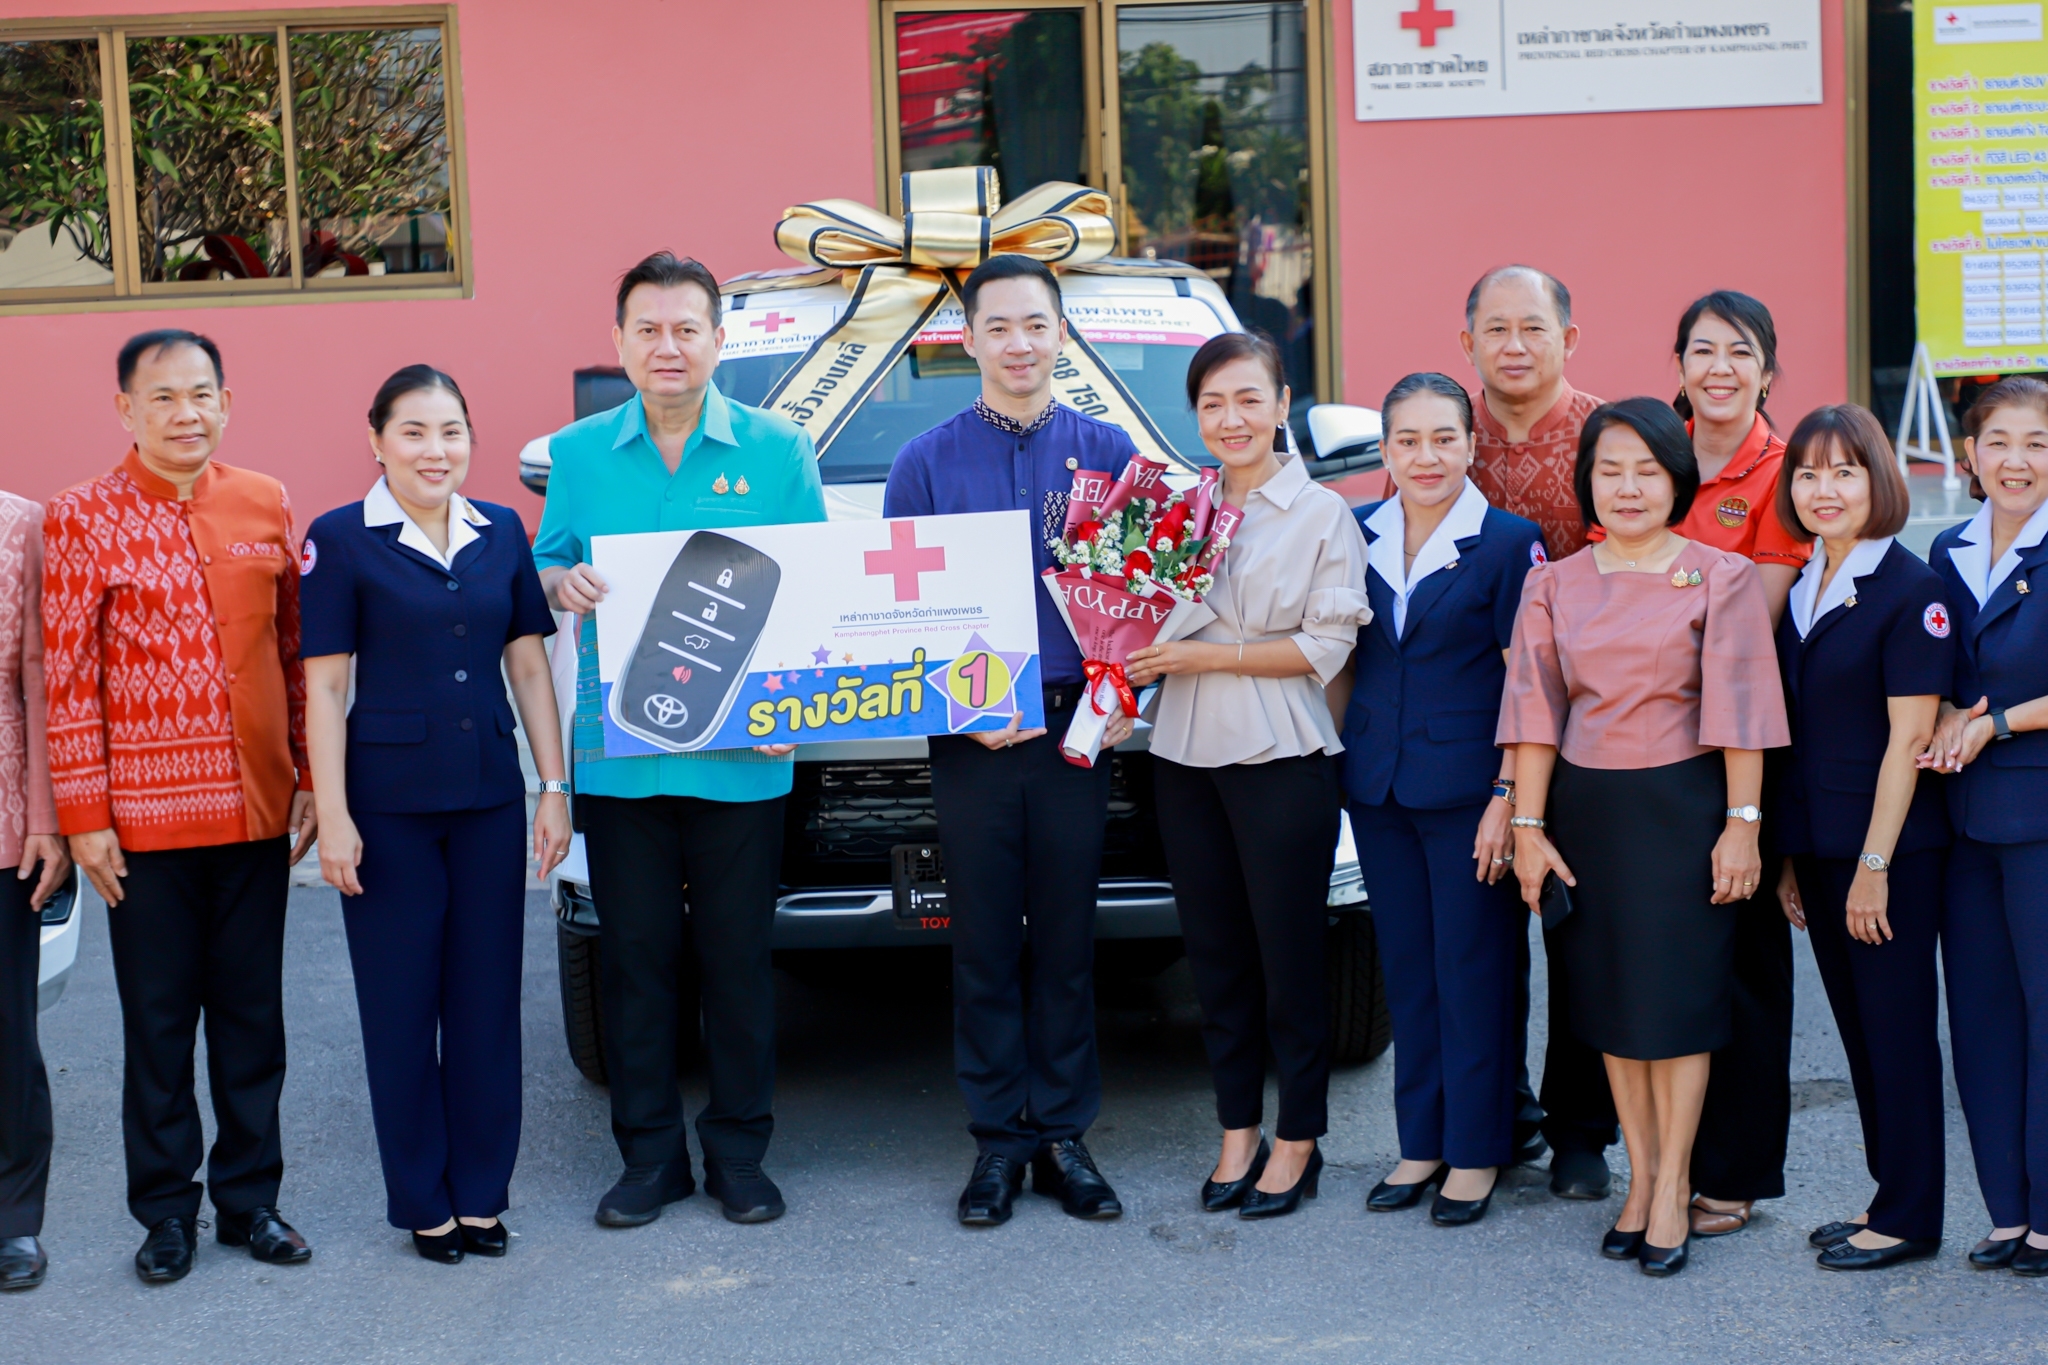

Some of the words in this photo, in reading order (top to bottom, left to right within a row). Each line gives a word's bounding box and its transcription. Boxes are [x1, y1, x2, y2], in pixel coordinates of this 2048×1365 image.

[1517, 21, 1770, 44] เหล่ากาชาดจังหวัดกำแพงเพชร
[1584, 49, 1603, 58] RED
[1607, 47, 1640, 57] CROSS
[1366, 54, 1488, 76] สภากาชาดไทย
[721, 333, 822, 350] สภากาชาดไท
[1052, 349, 1080, 380] 98
[1066, 383, 1109, 418] 750
[839, 605, 983, 623] เหล่ากาชาดจังหวัดกำแพงเพชร
[834, 628, 890, 638] Kamphaengphet
[892, 626, 922, 636] Province
[940, 624, 961, 632] Cross
[962, 622, 990, 631] Chapter
[747, 647, 926, 737] รางวัลที่
[958, 652, 989, 708] 1
[920, 917, 950, 929] TOY
